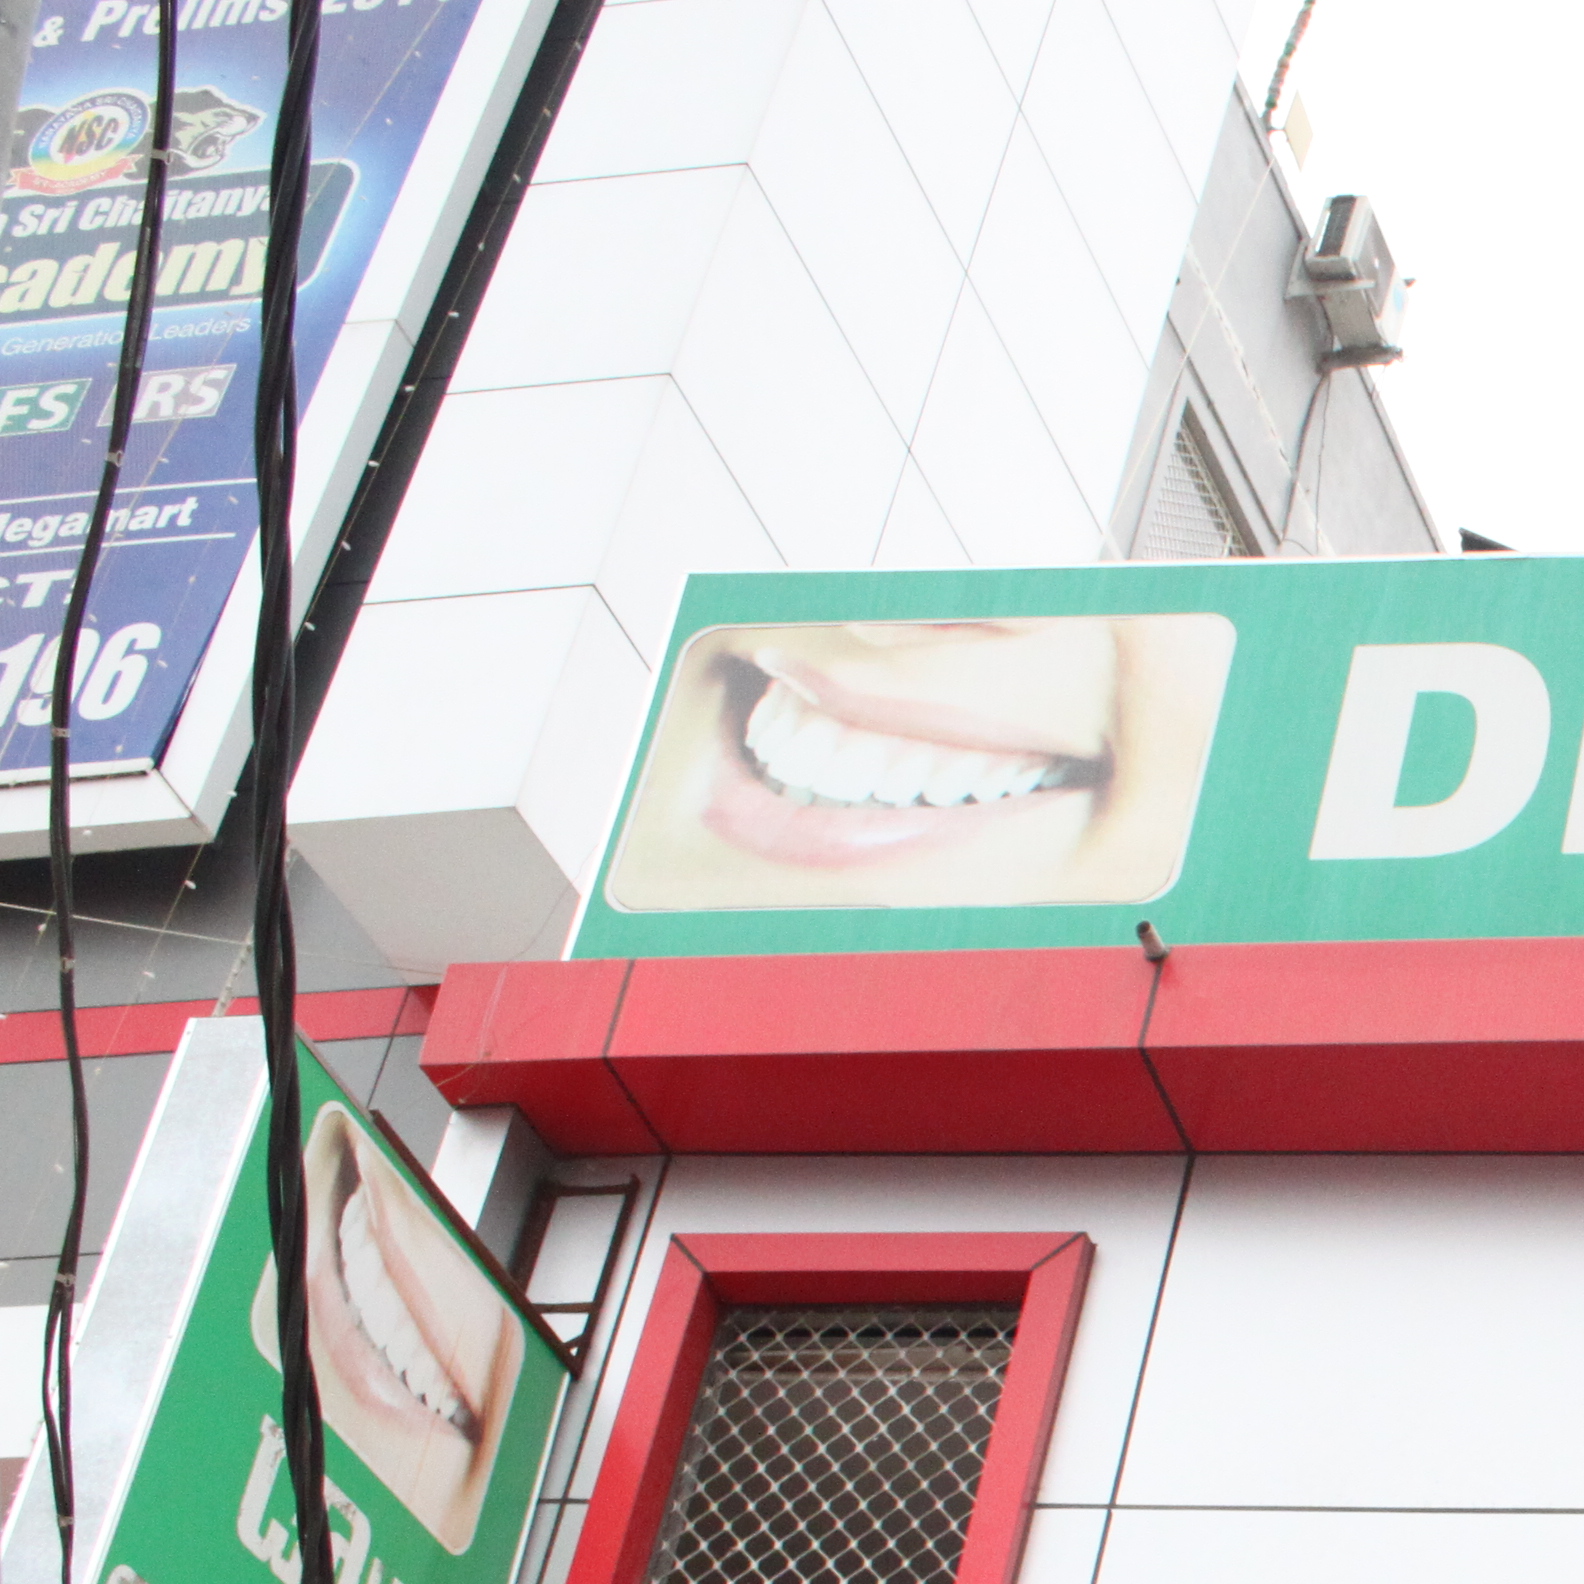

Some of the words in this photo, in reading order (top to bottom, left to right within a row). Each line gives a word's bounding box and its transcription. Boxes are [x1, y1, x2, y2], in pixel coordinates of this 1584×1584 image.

[33, 16, 64, 48] &
[11, 200, 78, 238] Sri
[0, 236, 270, 313] ademy
[1, 330, 125, 356] Generatio
[149, 317, 251, 341] Leaders
[0, 496, 199, 547] egamart
